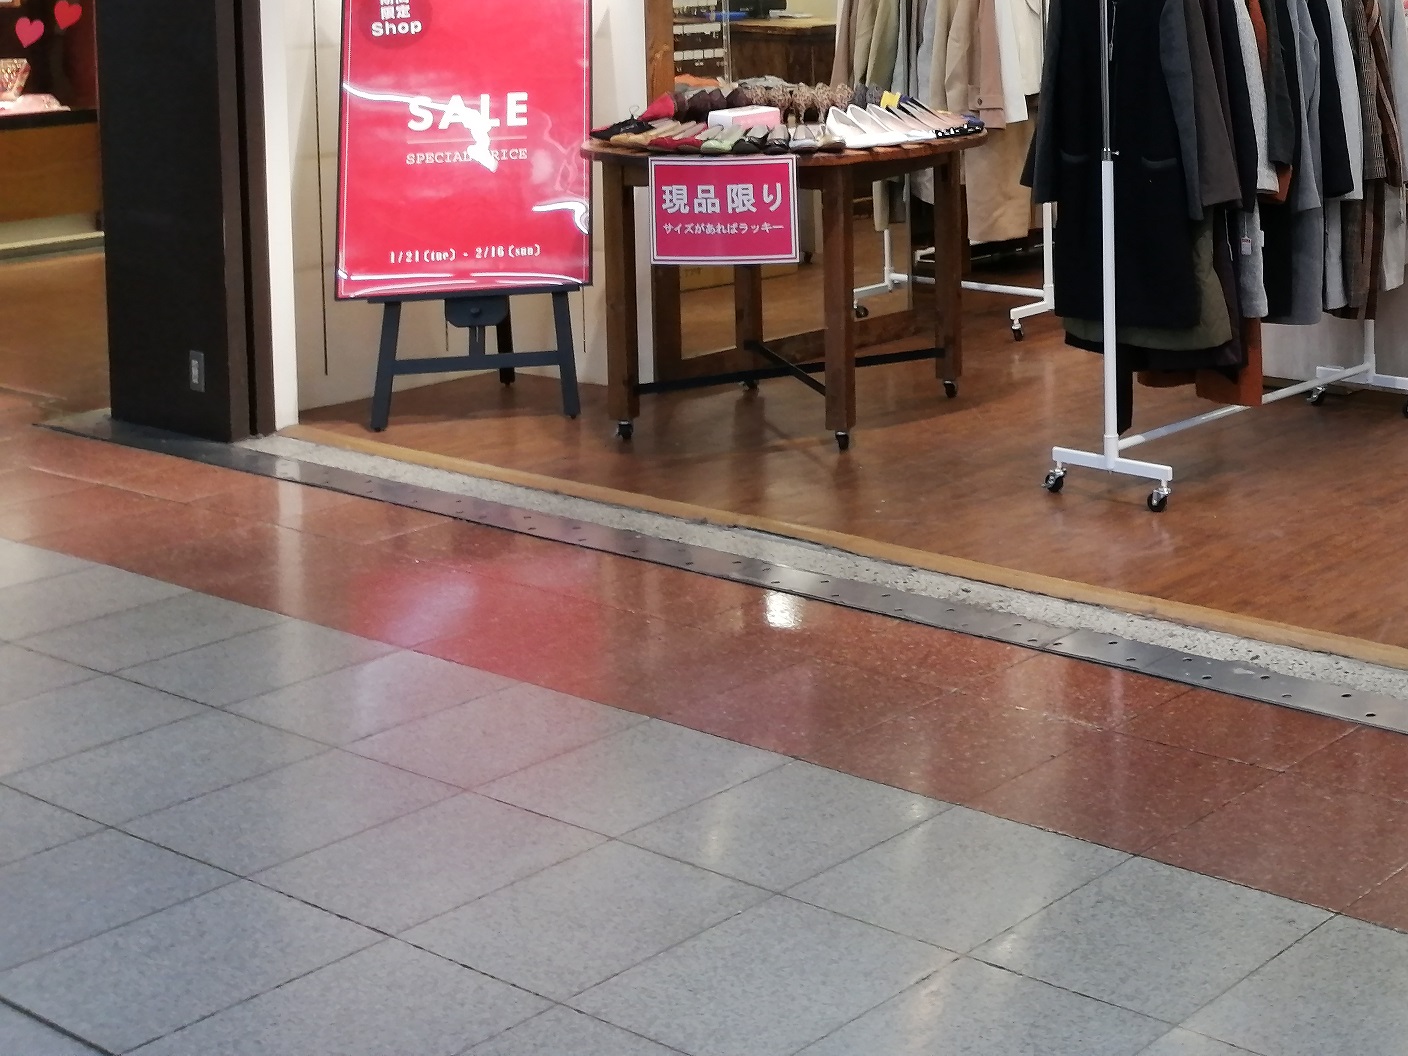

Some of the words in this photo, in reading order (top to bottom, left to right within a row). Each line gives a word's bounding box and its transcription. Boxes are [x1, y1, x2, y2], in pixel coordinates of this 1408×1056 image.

[371, 20, 422, 37] Shop
[407, 92, 528, 132] SALE
[481, 147, 528, 163] RICE
[661, 182, 783, 214] 現品限り
[662, 221, 784, 235] サイズがあればラッキー
